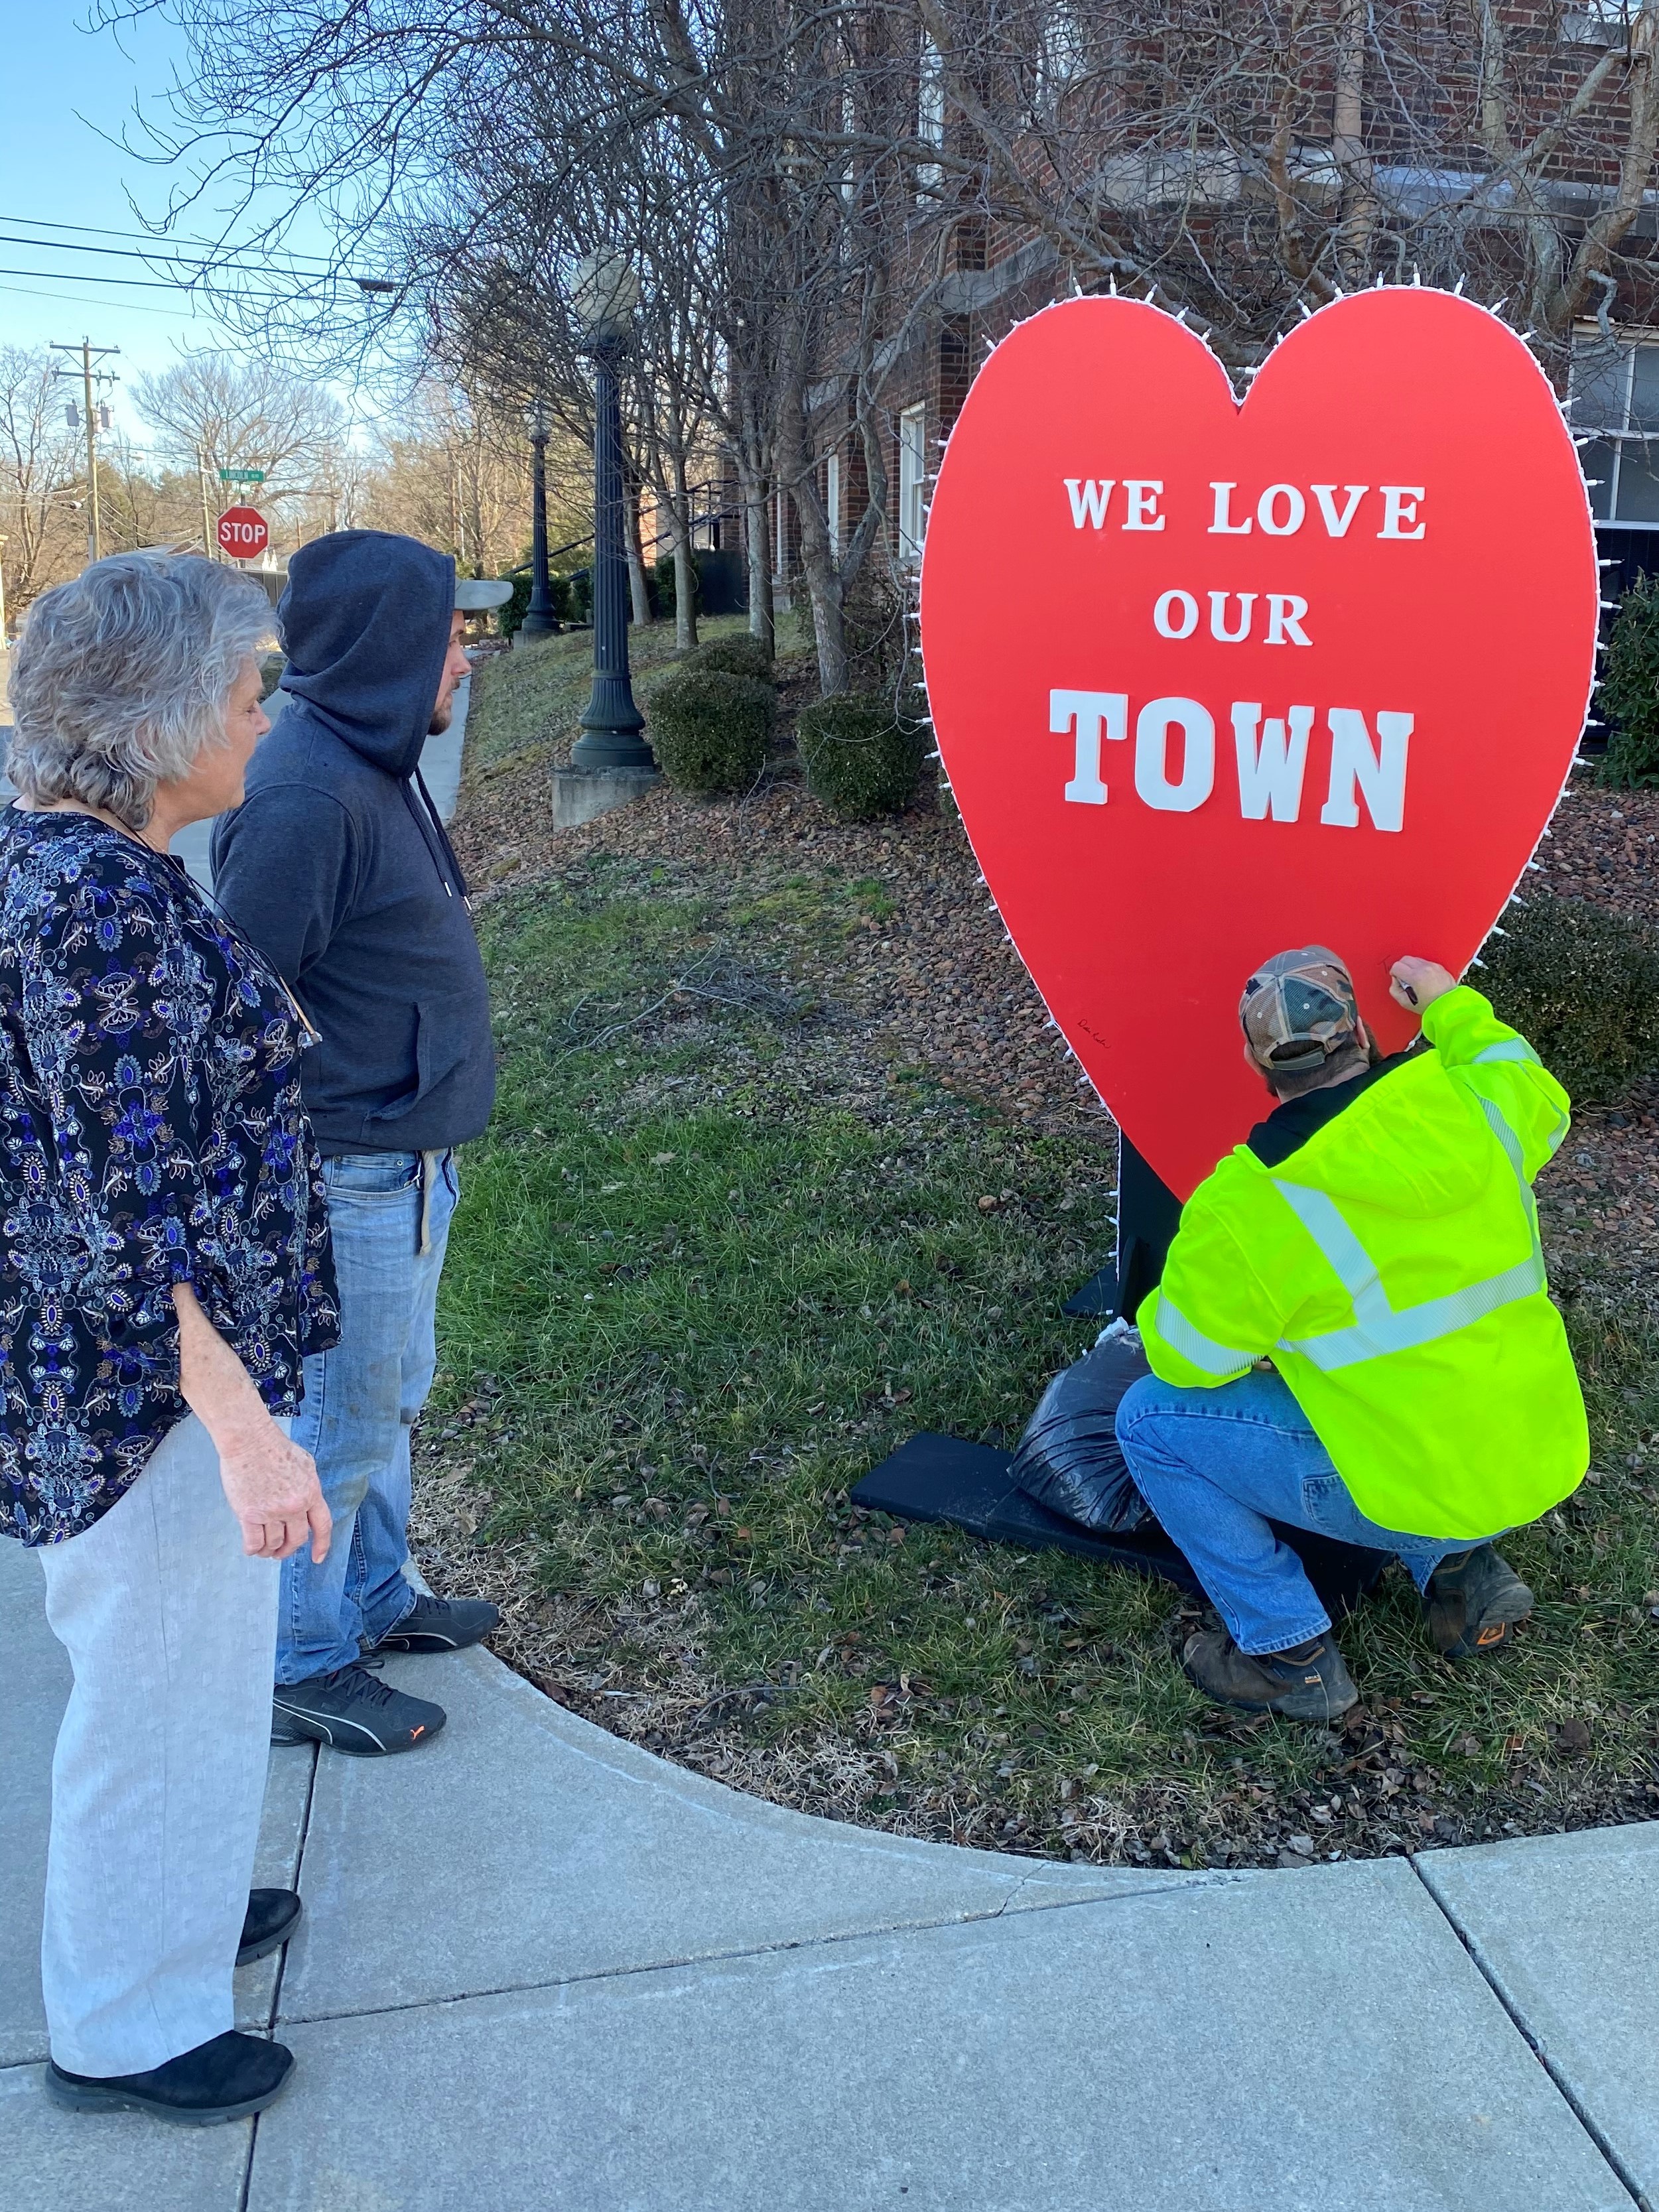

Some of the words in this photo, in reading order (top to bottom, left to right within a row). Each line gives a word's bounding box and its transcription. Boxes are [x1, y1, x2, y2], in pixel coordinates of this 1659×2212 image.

[226, 470, 249, 480] LINCOLN
[220, 521, 265, 543] STOP
[1063, 478, 1166, 531] WE
[1207, 482, 1427, 540] LOVE
[1153, 589, 1314, 646] OUR
[1049, 689, 1414, 832] TOWN
